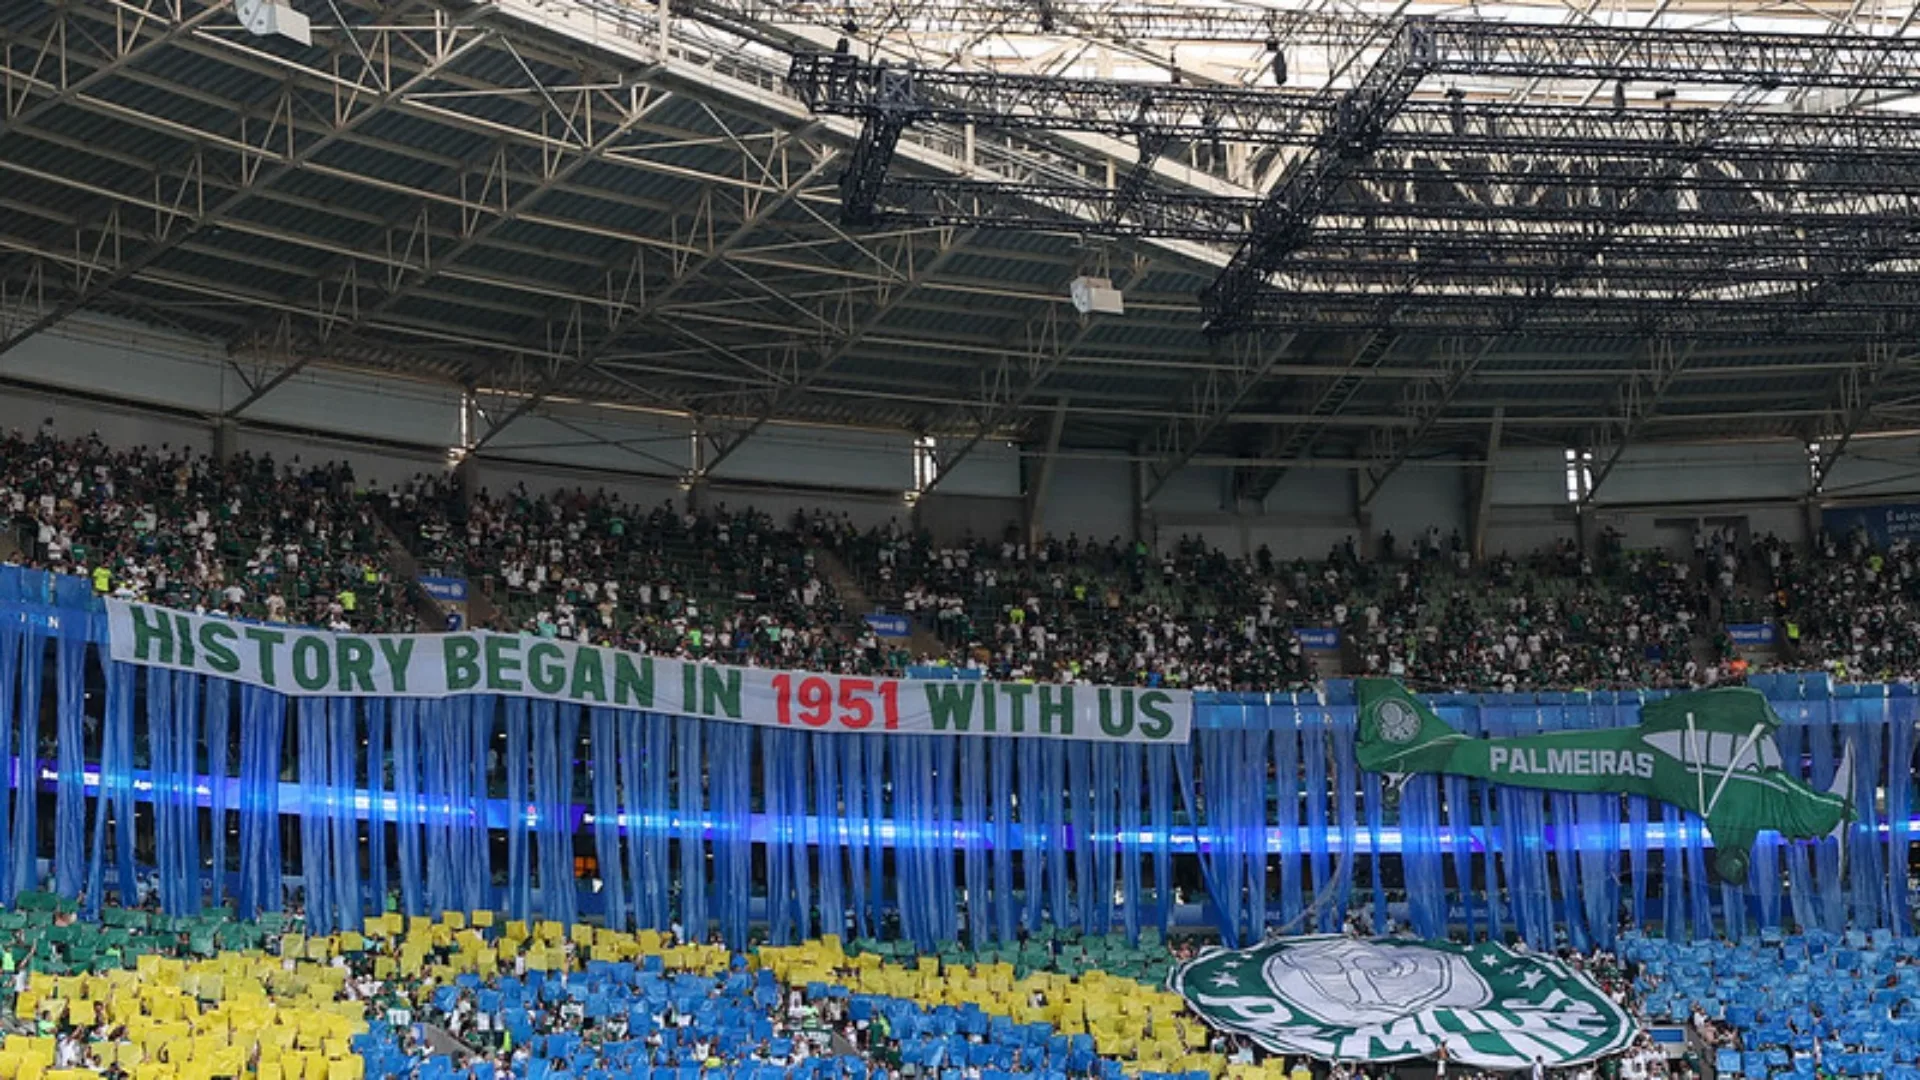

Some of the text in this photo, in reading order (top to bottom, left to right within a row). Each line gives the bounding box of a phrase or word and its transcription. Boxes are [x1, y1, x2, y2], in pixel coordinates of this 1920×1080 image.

[133, 609, 1174, 738] HISTORY BEGAN IN 1951 WITH US
[1489, 746, 1655, 778] PALMEIRAS
